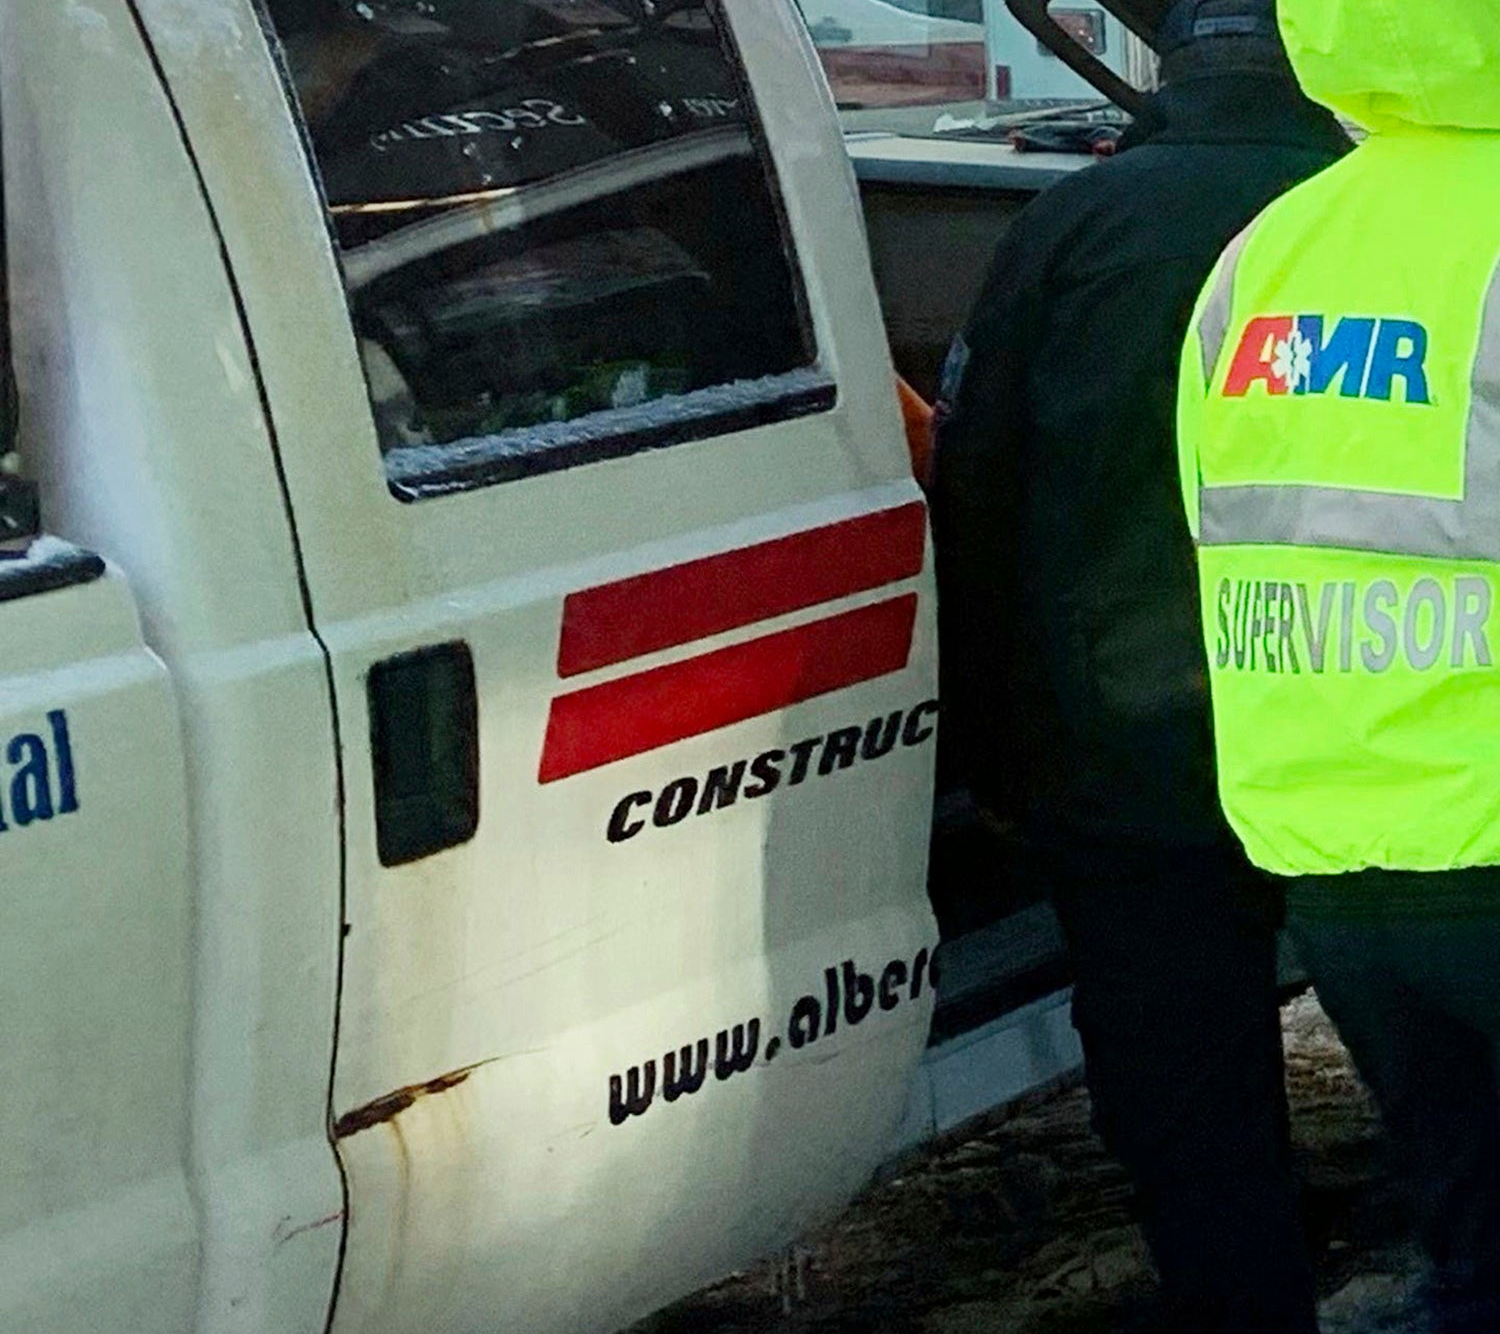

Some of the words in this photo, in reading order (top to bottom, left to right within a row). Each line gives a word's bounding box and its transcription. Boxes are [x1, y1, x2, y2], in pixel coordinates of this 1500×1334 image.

[1222, 314, 1434, 405] AMR
[1216, 575, 1495, 673] SUPERVISOR
[0, 708, 80, 833] al
[606, 699, 939, 845] CONSTRUC
